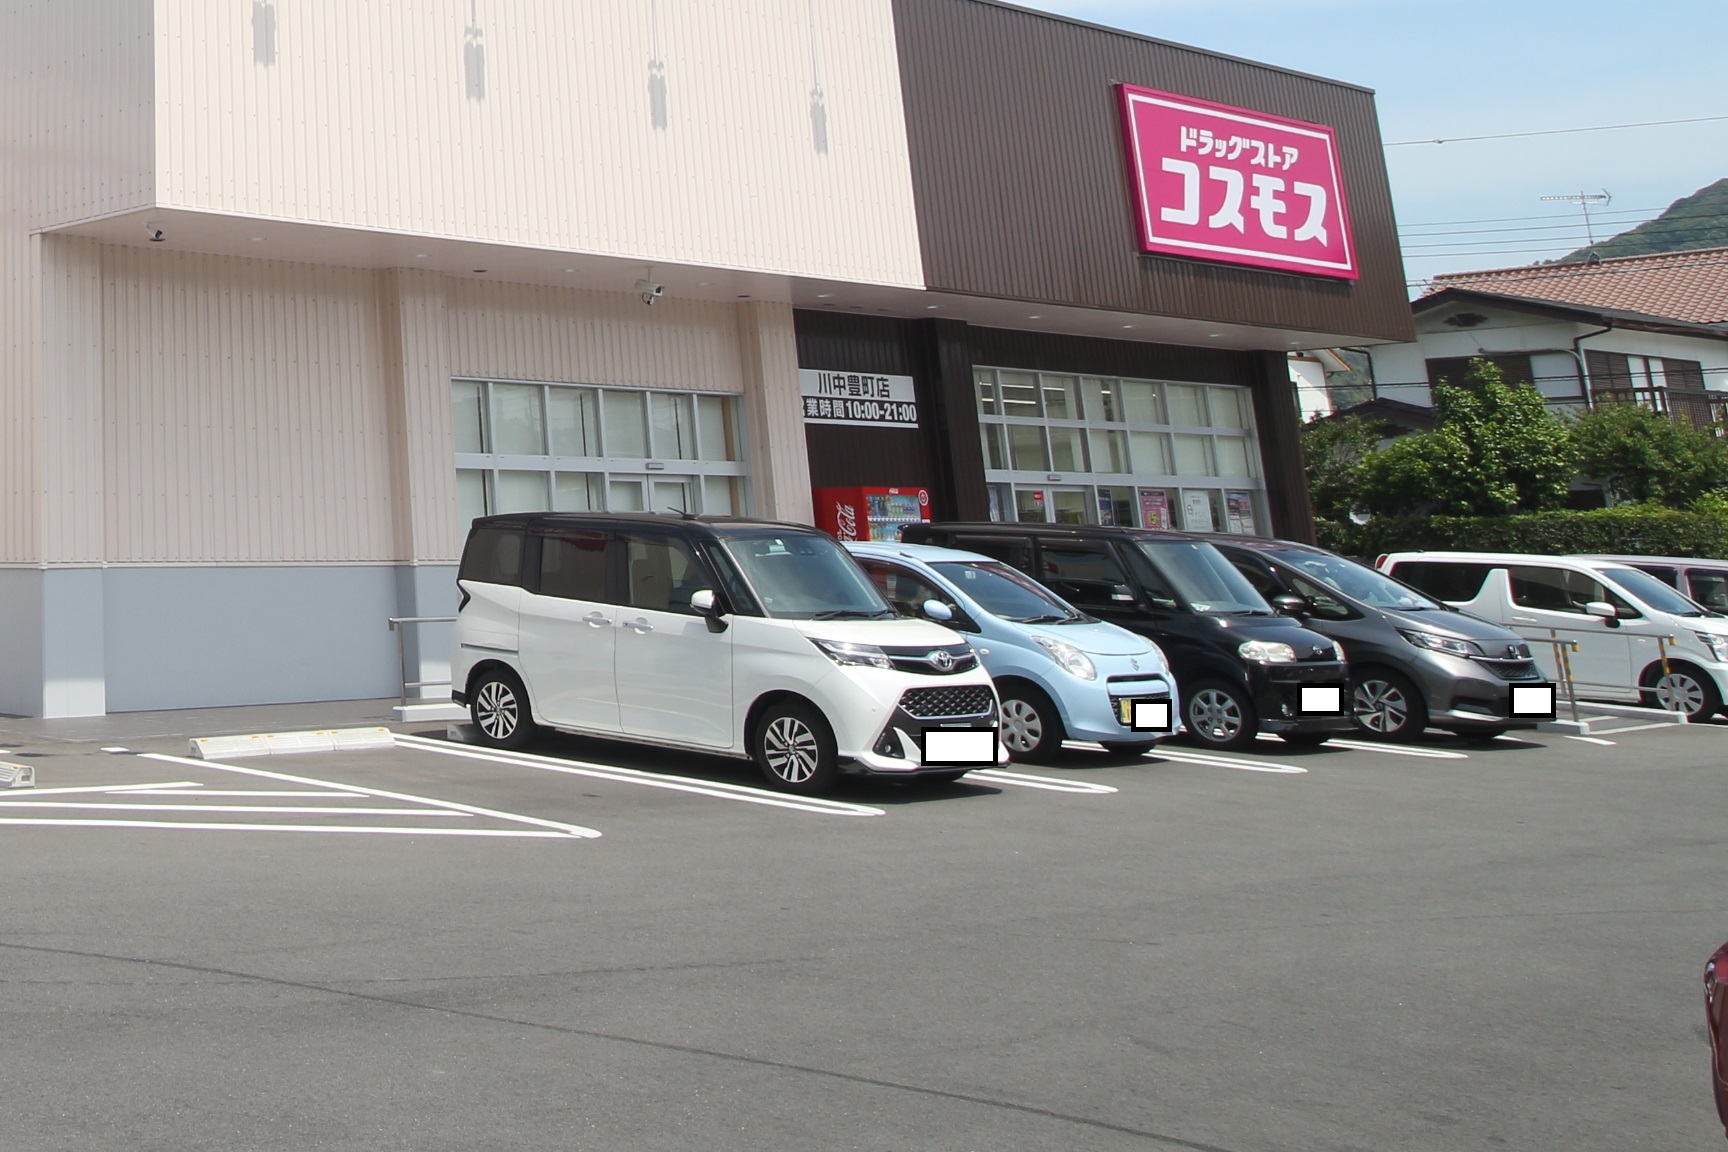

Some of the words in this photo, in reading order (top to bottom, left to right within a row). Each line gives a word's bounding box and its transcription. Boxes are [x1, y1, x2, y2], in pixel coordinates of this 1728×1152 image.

[1180, 125, 1299, 171] ドラッグストア
[1160, 156, 1328, 248] コスモス
[818, 372, 891, 399] 川中豊町店
